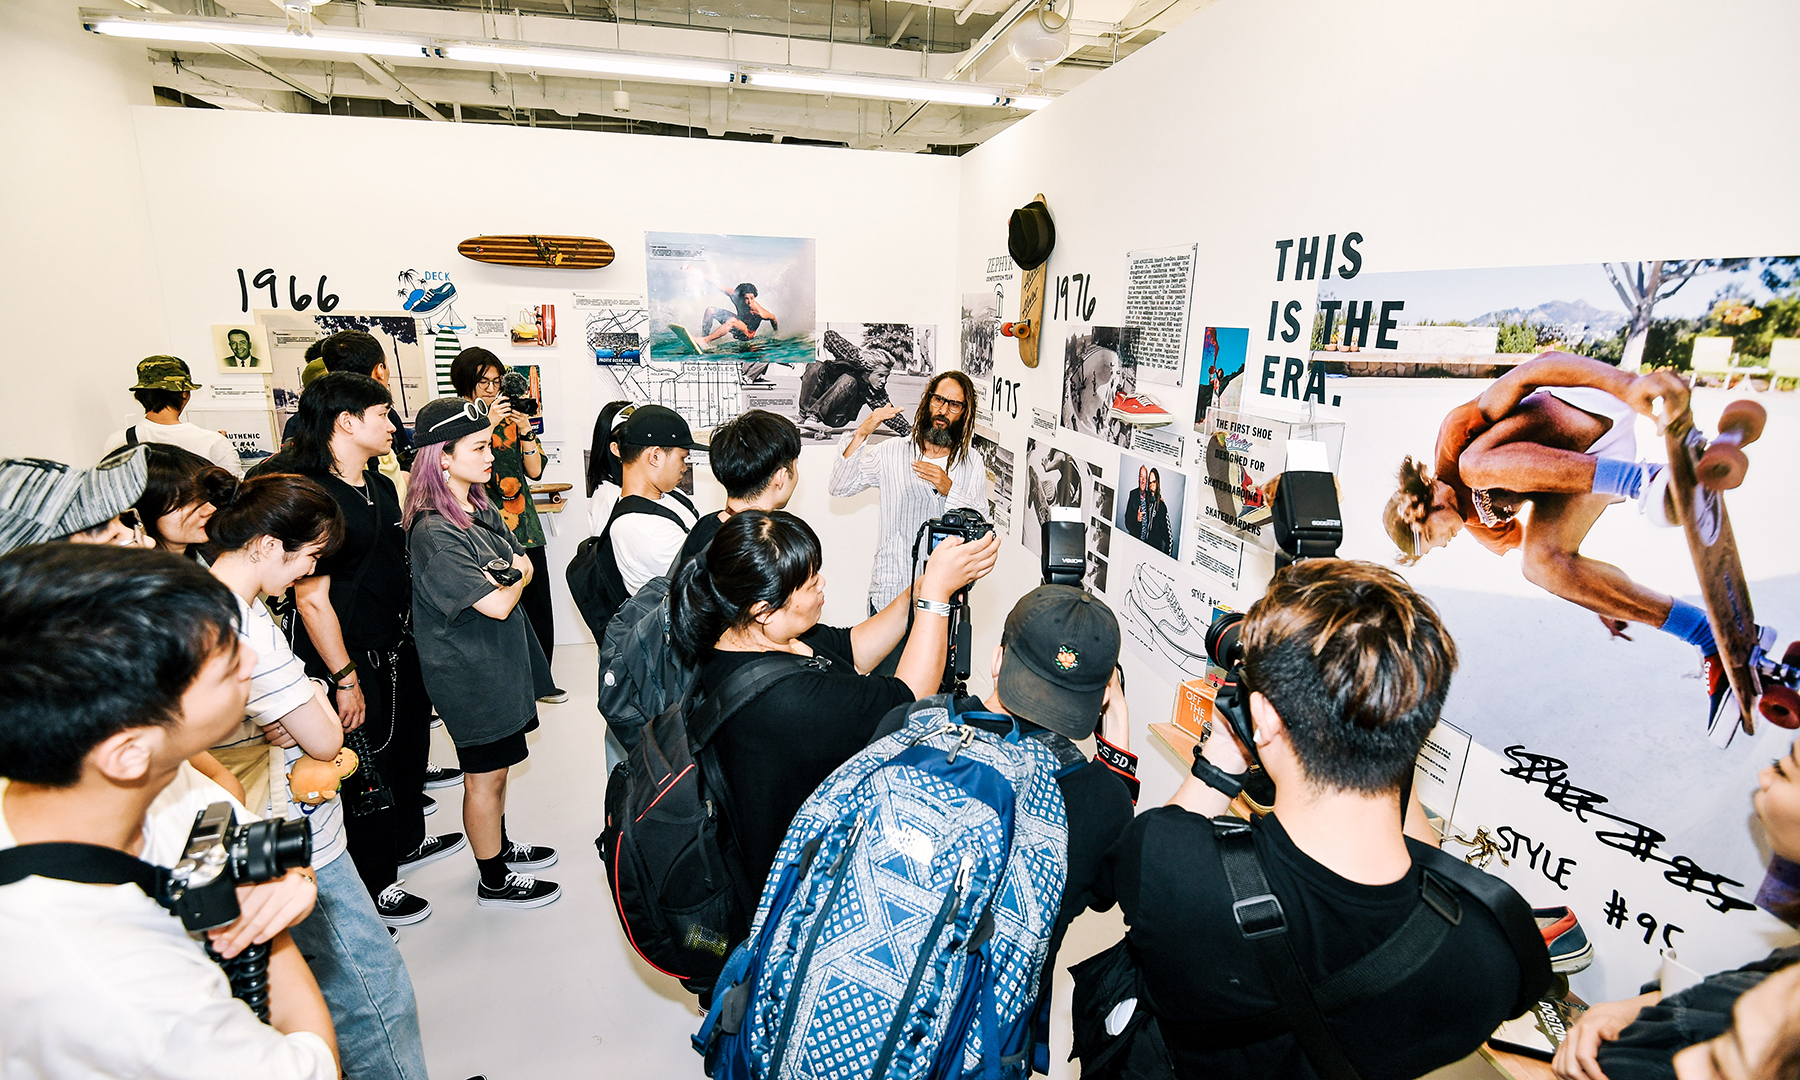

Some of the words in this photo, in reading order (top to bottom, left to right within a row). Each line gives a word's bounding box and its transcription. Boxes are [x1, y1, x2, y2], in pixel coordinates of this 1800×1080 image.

[986, 255, 1013, 273] ZEPHYR
[1275, 232, 1364, 282] THIS
[424, 270, 450, 282] DECK
[237, 268, 340, 313] 1966
[1054, 273, 1096, 322] 1976
[1268, 300, 1302, 342] IS
[1320, 300, 1404, 350] THE
[1260, 355, 1342, 407] ERA.
[991, 375, 1020, 419] 1975
[1216, 419, 1228, 430] THE
[1230, 422, 1250, 435] FIRST
[1252, 427, 1273, 440] SHOE
[1214, 449, 1248, 467] DESIGNED
[1250, 459, 1265, 472] FOR
[1204, 476, 1258, 503] SKATEBOARDING
[1205, 506, 1261, 536] SKATEBOARDERS
[1191, 588, 1205, 603] STYLE
[1186, 691, 1202, 705] OFF
[1190, 702, 1205, 718] THE
[1111, 752, 1129, 768] 5D
[1497, 826, 1577, 890] STYLE
[1603, 889, 1685, 956] #95
